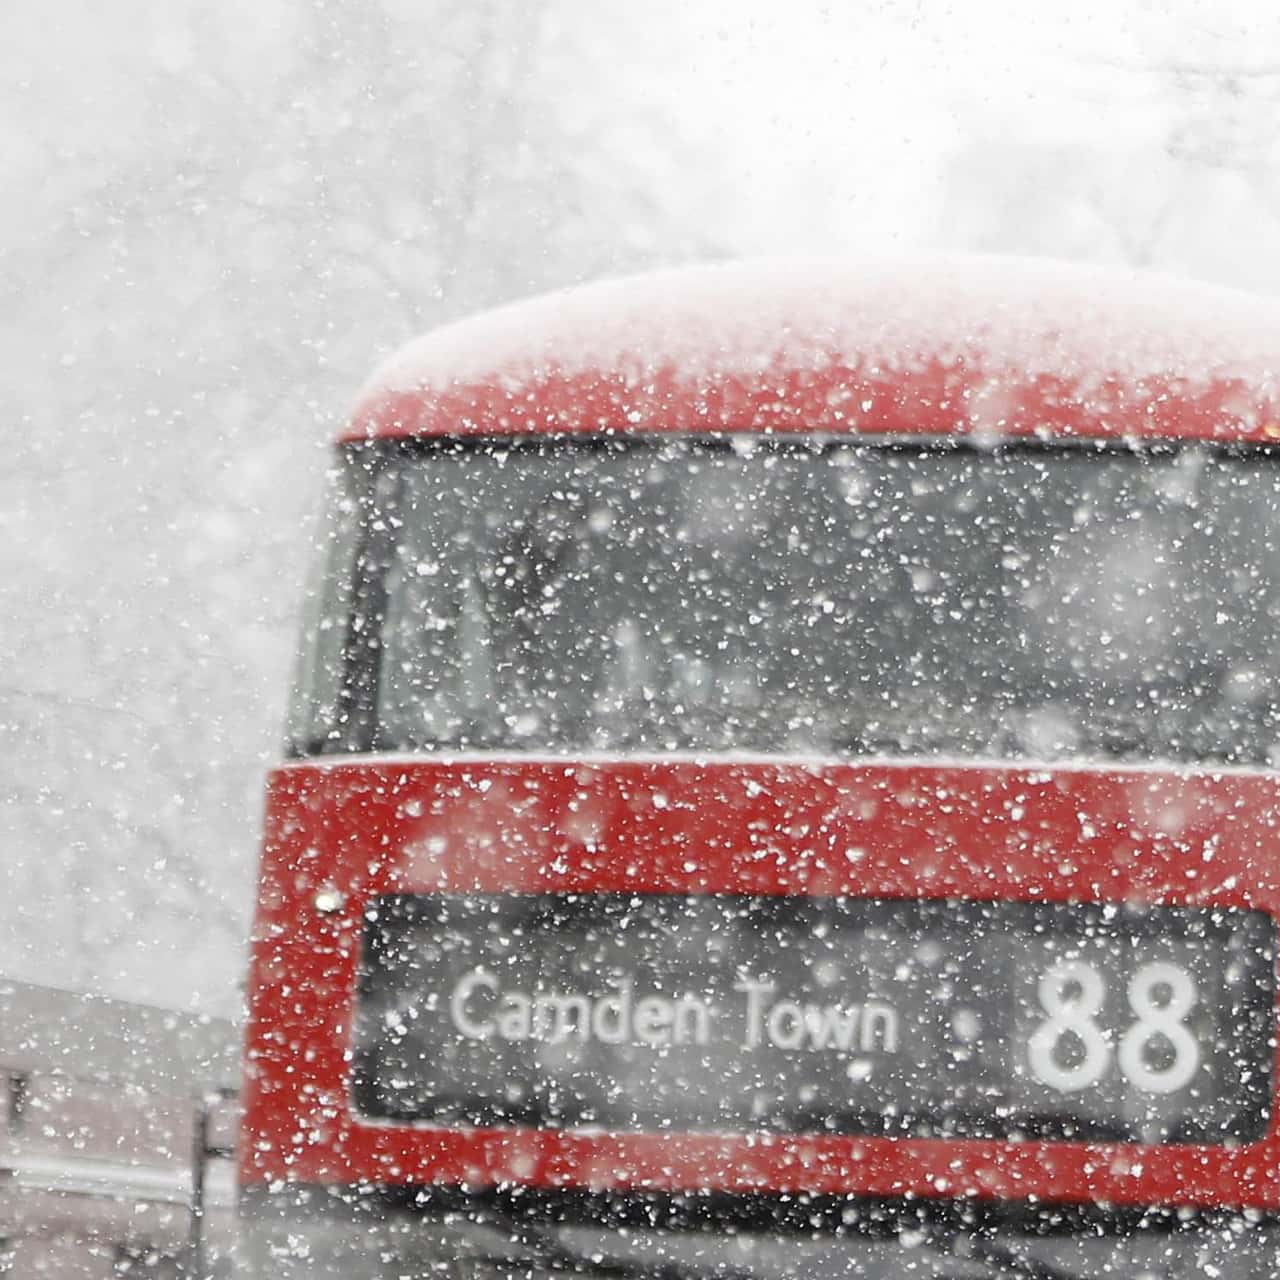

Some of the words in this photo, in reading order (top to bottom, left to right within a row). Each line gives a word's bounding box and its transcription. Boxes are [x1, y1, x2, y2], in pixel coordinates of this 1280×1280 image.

[451, 972, 714, 1047] Camden
[731, 978, 899, 1056] Town
[1028, 961, 1201, 1093] 88
